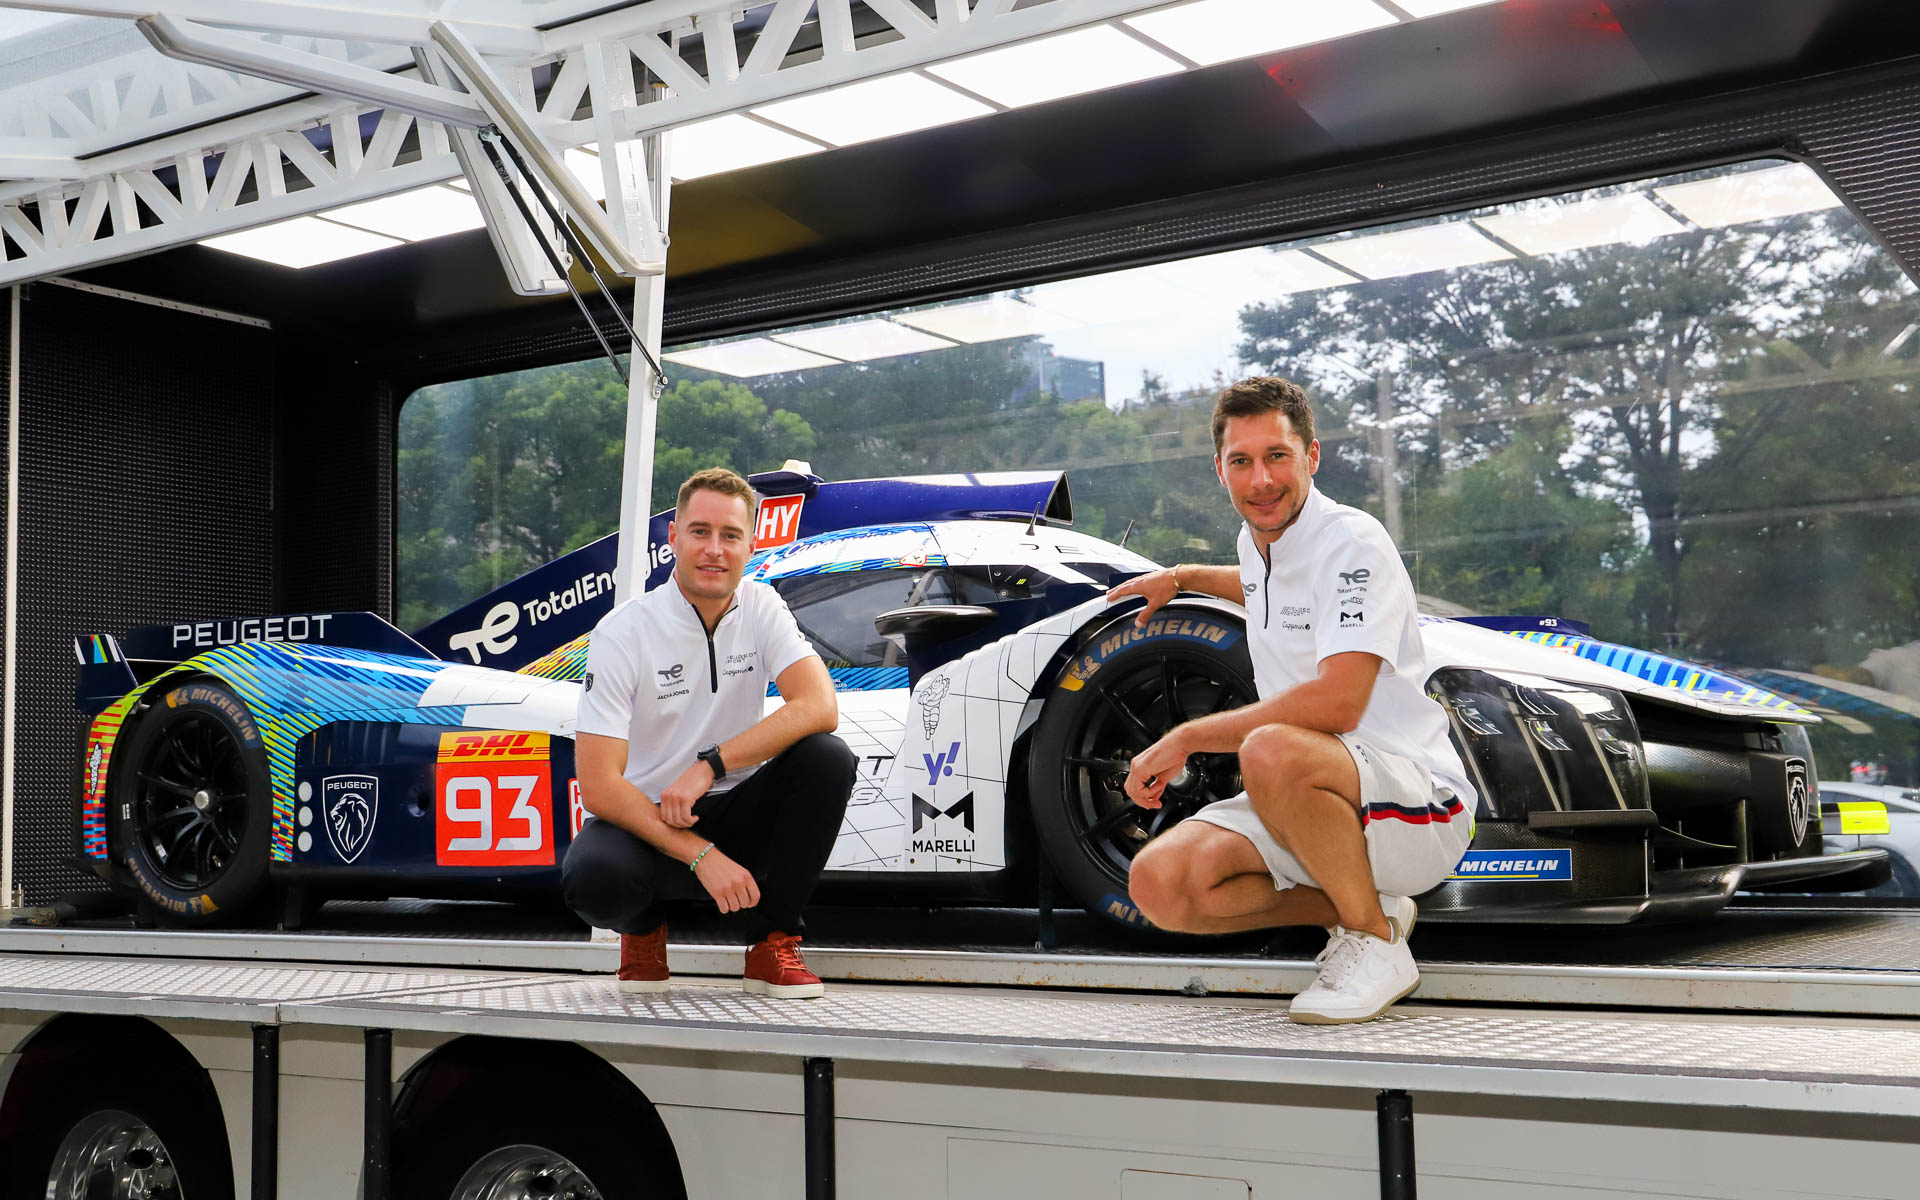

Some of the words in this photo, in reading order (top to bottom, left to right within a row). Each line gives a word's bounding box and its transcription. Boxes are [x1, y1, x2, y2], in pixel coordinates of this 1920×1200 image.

[758, 504, 799, 540] HY
[173, 614, 333, 648] PEUGEOT
[1101, 619, 1228, 659] MICHELIN
[1538, 618, 1558, 627] #93
[191, 688, 256, 742] MICHELIN
[452, 734, 534, 757] DHL
[327, 781, 374, 791] PEUGEOT
[445, 775, 542, 851] 93
[912, 840, 975, 852] MARELLI
[1460, 859, 1560, 872] MICHELIN
[128, 857, 188, 913] MICHELIN
